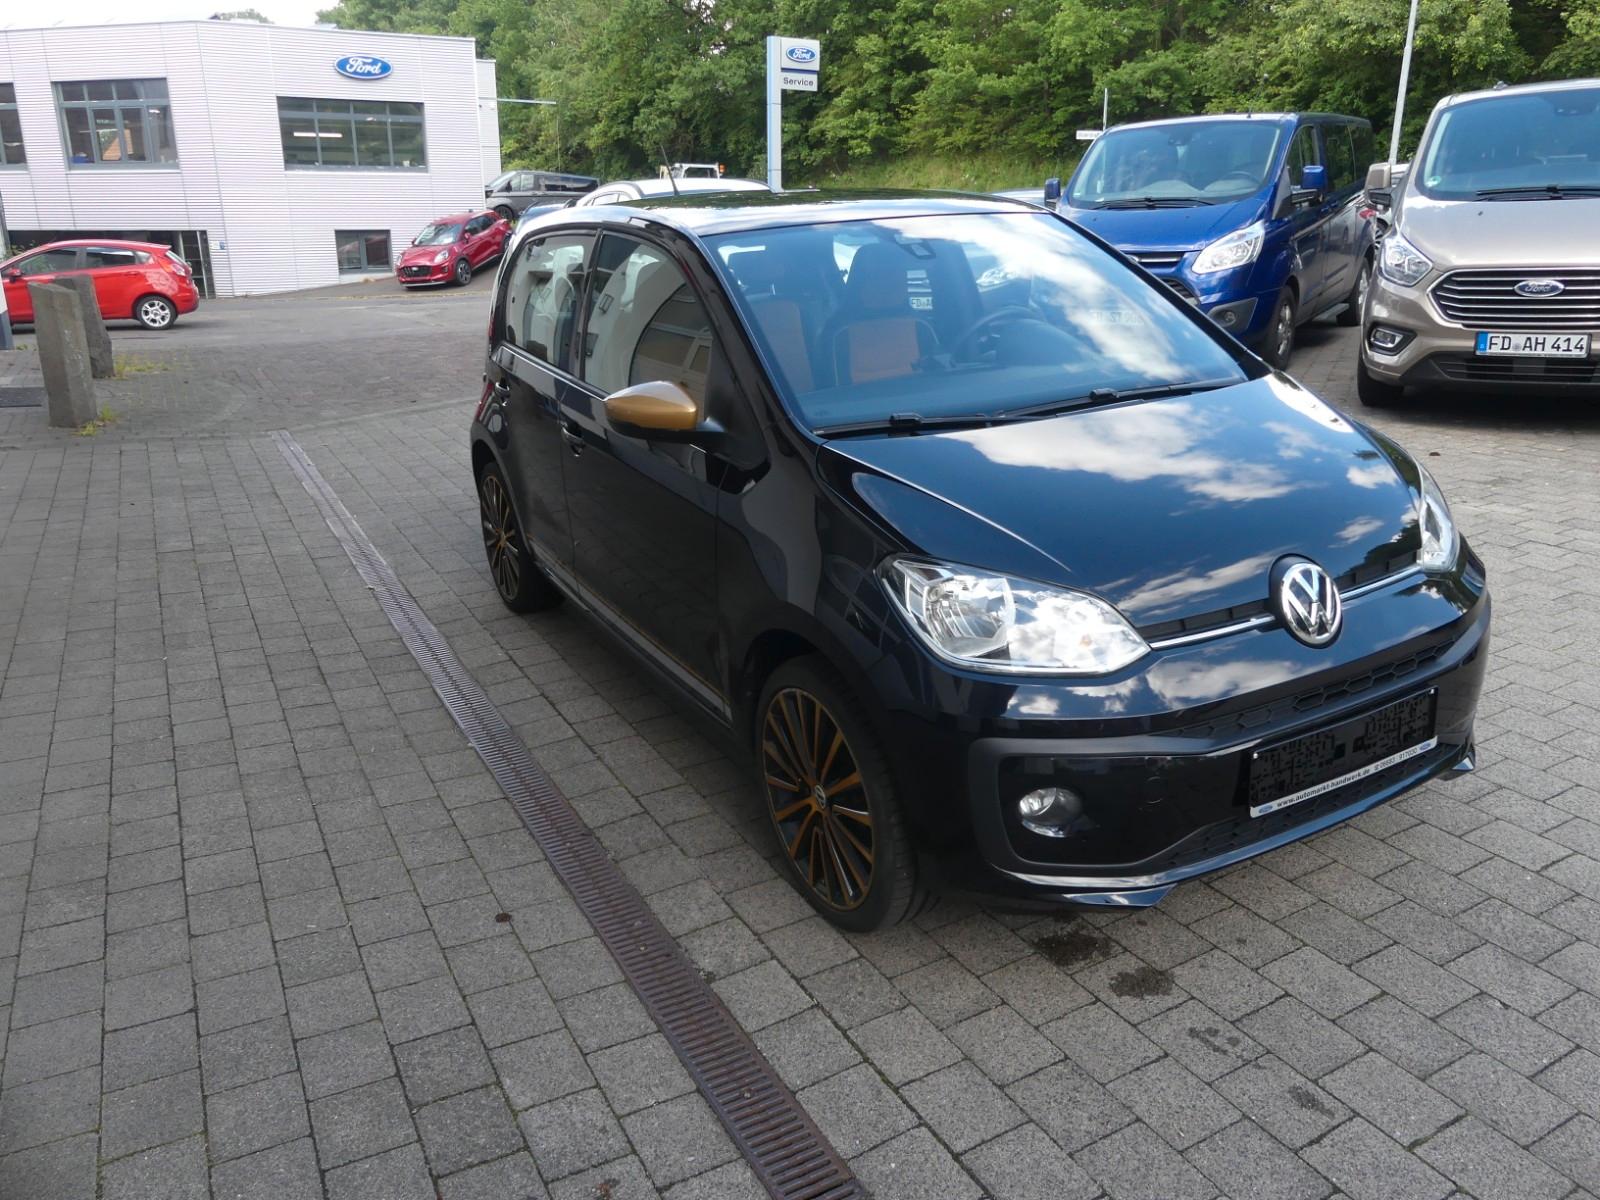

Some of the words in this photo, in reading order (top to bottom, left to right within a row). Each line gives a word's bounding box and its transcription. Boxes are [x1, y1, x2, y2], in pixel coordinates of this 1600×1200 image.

[792, 47, 811, 60] Ford
[345, 56, 382, 75] Ford
[783, 76, 814, 87] Service
[1488, 335, 1512, 351] FD
[1522, 336, 1546, 352] AH
[1551, 337, 1585, 353] 414
[1277, 768, 1371, 807] www.automarkt-handwerk.de
